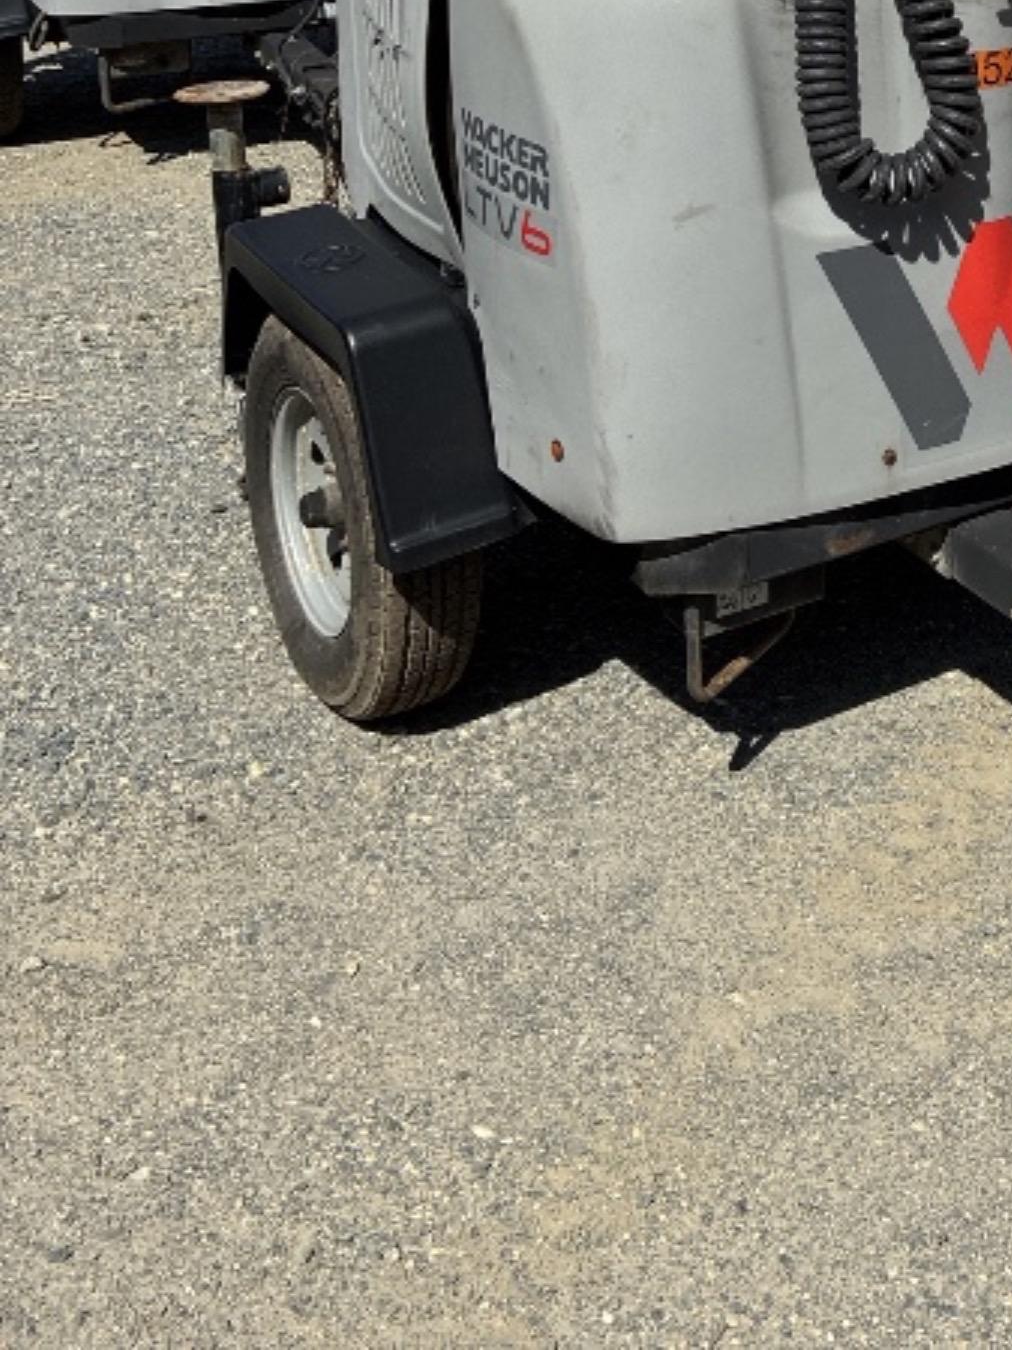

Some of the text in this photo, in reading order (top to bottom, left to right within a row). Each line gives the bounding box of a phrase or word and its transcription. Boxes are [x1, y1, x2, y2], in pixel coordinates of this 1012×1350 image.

[461, 107, 549, 178] WACKER
[463, 142, 549, 211] NEUSON
[465, 185, 553, 256] LTV6
